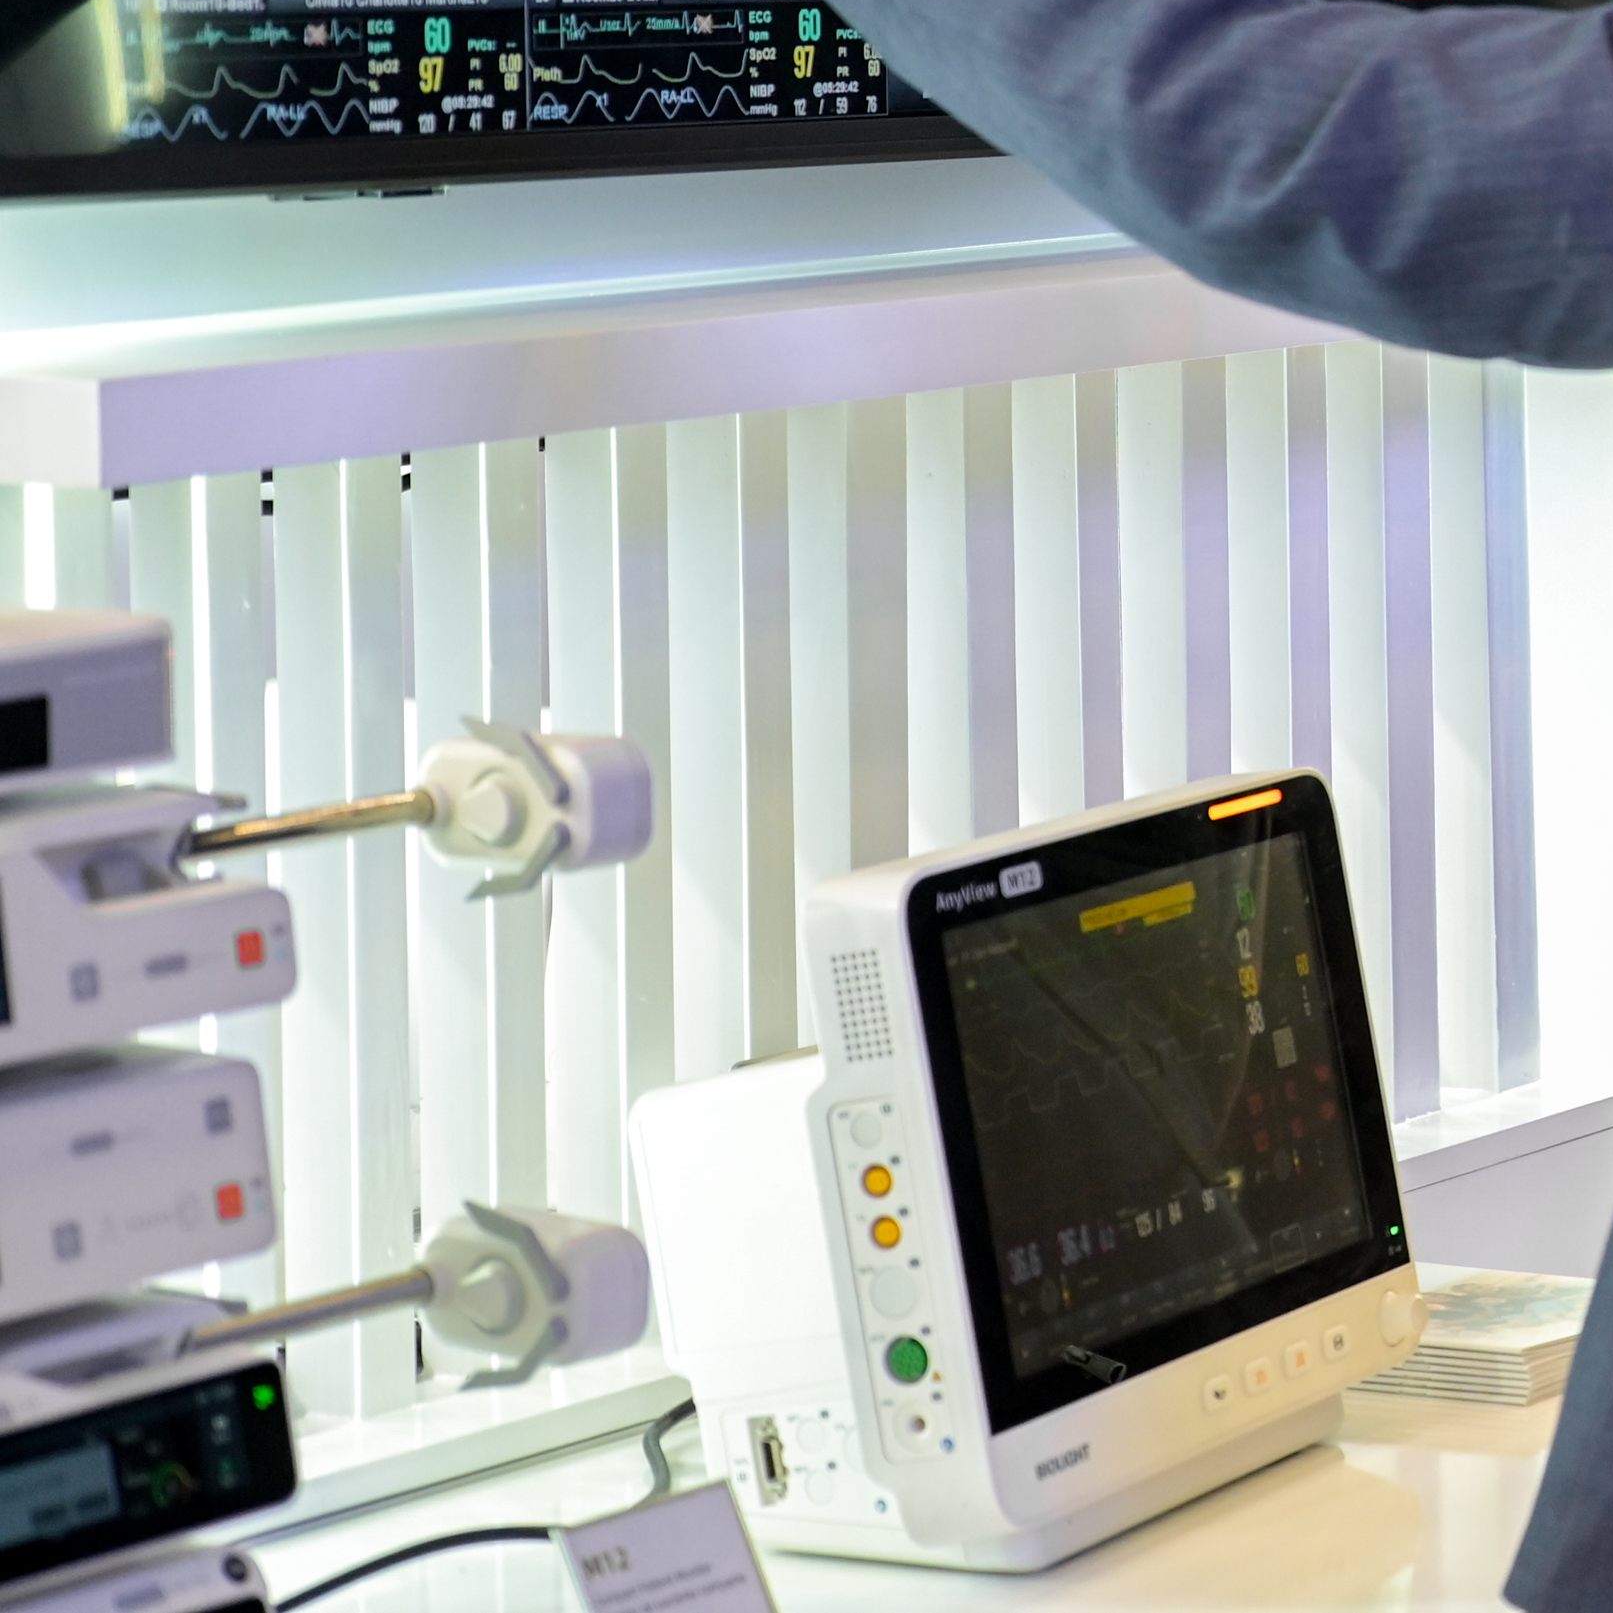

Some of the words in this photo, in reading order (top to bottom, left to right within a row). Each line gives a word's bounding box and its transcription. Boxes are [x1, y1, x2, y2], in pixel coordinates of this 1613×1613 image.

[799, 8, 821, 42] 60
[793, 45, 815, 79] 97
[936, 882, 998, 914] AnyView
